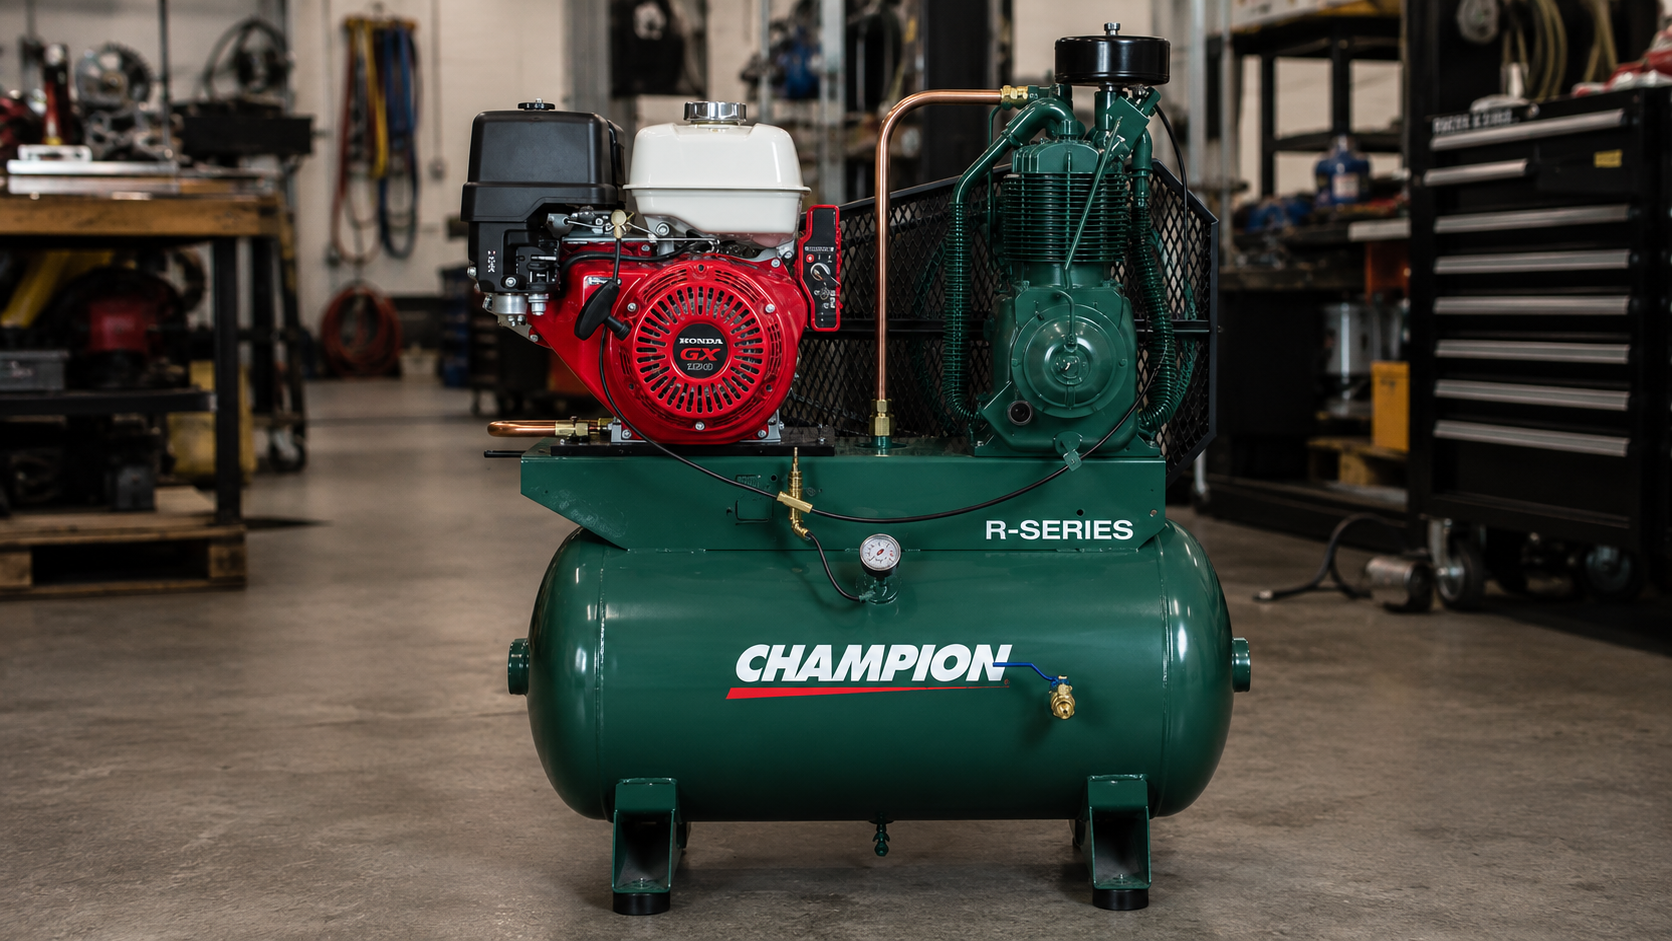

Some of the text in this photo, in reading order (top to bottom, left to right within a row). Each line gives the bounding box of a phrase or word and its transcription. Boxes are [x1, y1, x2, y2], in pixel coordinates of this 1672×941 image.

[680, 347, 721, 361] GX
[985, 519, 1134, 540] R-SERIES
[736, 643, 1013, 683] CHAMPION
